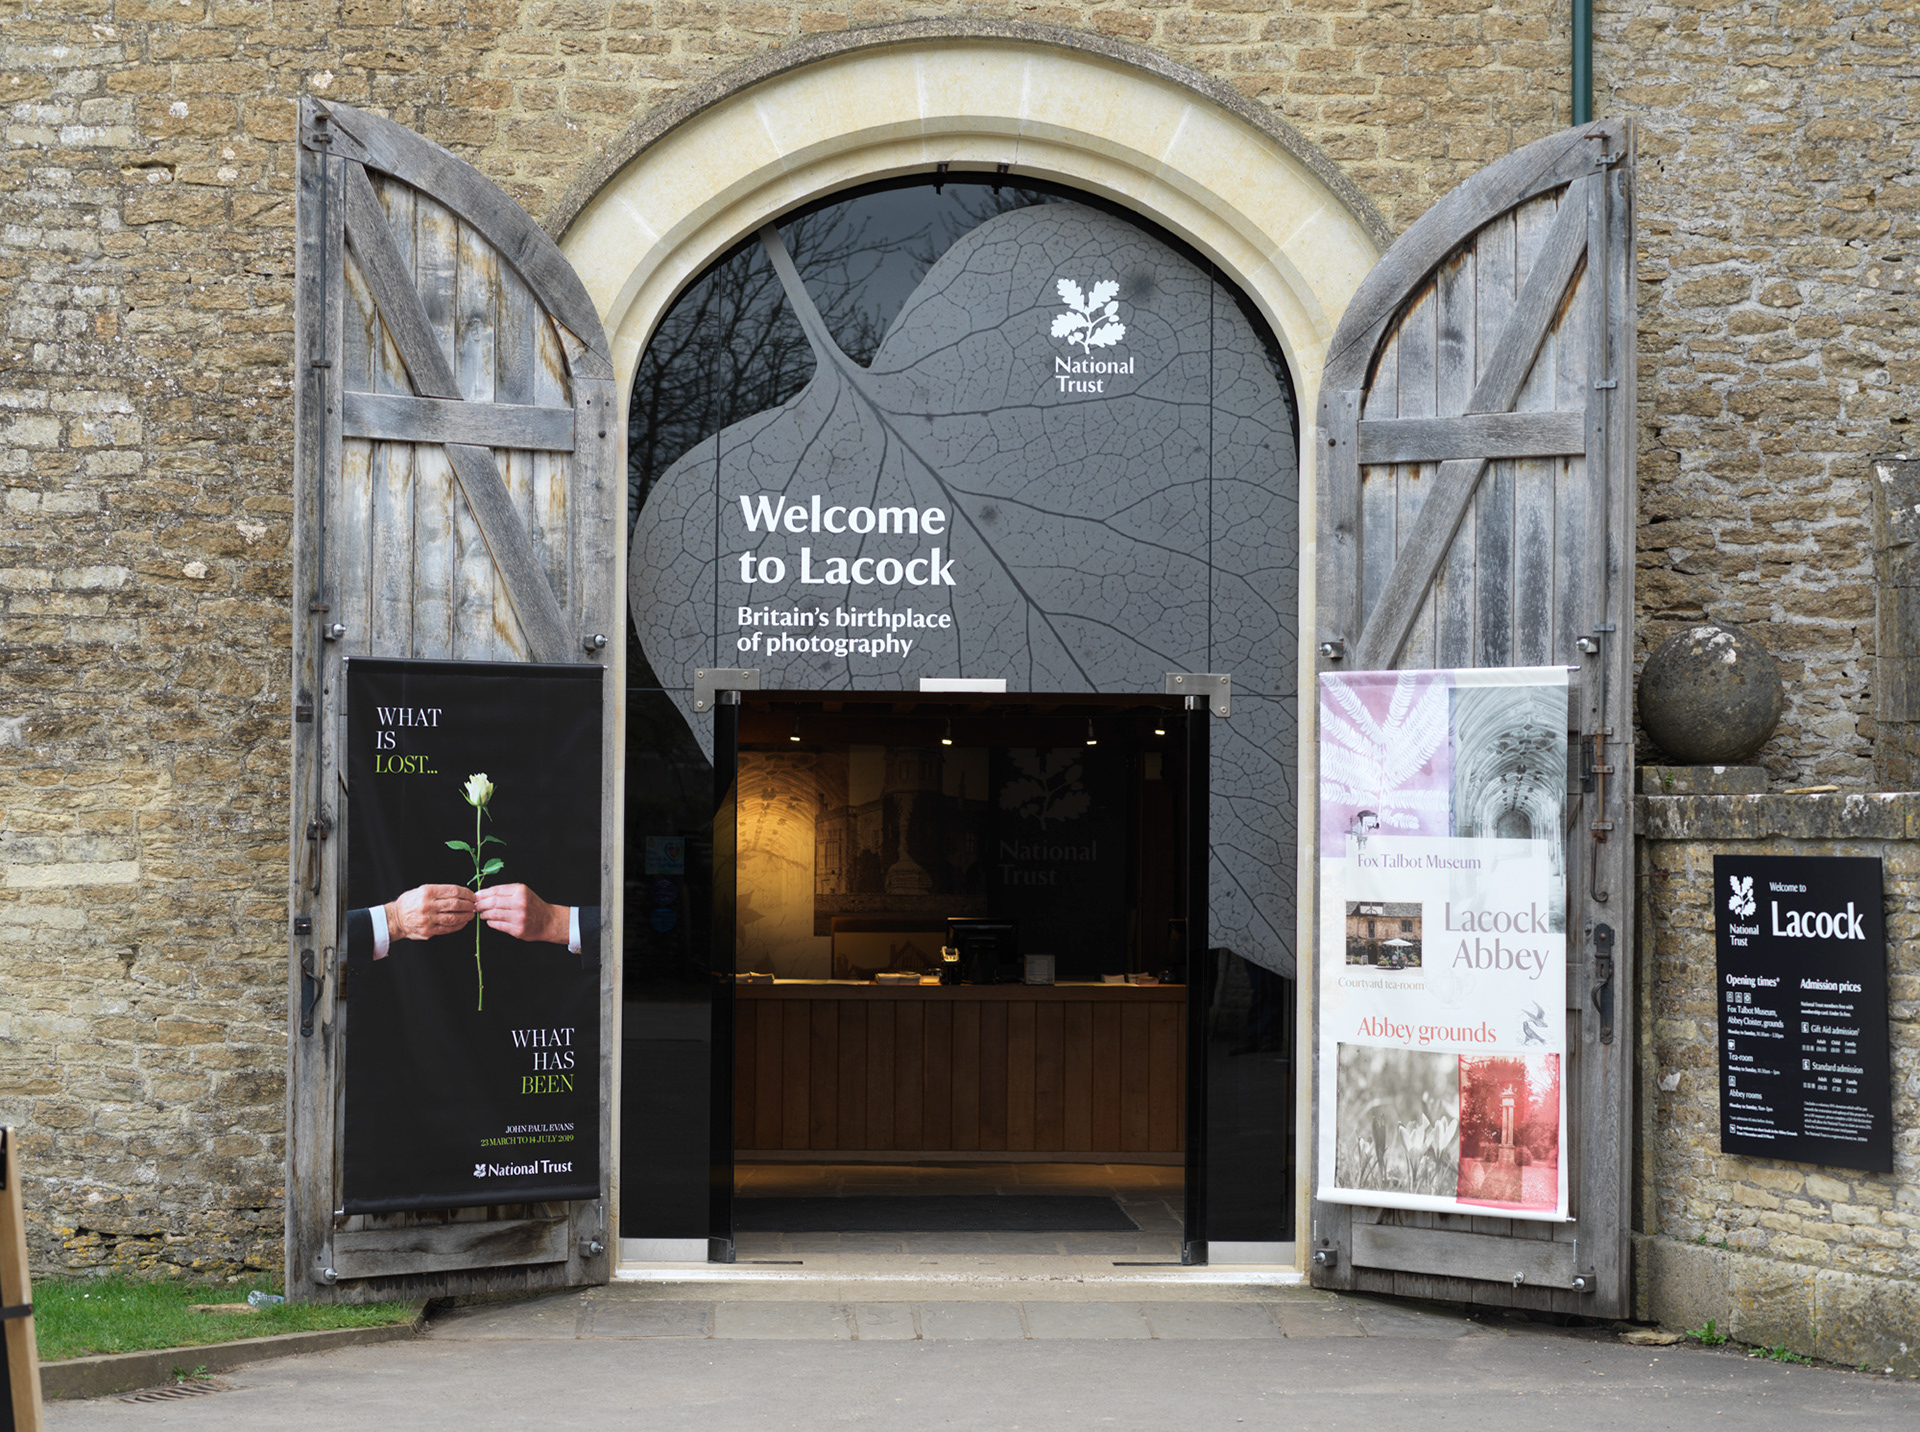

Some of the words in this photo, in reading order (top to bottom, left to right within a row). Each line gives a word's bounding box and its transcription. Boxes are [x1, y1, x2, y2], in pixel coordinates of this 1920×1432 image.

[1055, 356, 1134, 374] National
[1055, 375, 1104, 392] Trust
[739, 494, 946, 535] Welcome
[738, 550, 786, 584] to
[800, 547, 957, 586] Lacock
[737, 606, 830, 628] Britain’s
[836, 607, 951, 633] birthplace
[737, 632, 763, 652] of
[766, 632, 913, 658] photography
[376, 706, 442, 727] WHAT
[376, 730, 396, 750] IS
[375, 754, 438, 774] LOST...
[1000, 840, 1097, 861] National
[1357, 853, 1379, 868] Fox
[1380, 853, 1423, 869] Talbot
[1426, 854, 1482, 870] Museum
[998, 864, 1057, 886] Trust
[1769, 882, 1798, 893] Welcome
[1799, 883, 1807, 893] to
[1445, 901, 1549, 934] Lacock
[1771, 900, 1866, 940] Lacock
[1729, 924, 1760, 935] National
[1729, 935, 1748, 947] Trust
[1452, 937, 1550, 981] Abbey
[1338, 976, 1383, 991] Courtyard
[1385, 978, 1425, 991] tea-room
[1726, 974, 1756, 988] Opening
[1800, 978, 1838, 991] Admission
[1839, 981, 1862, 994] prices
[1727, 1005, 1737, 1013] Fox
[1737, 1005, 1754, 1014] Talbot
[1357, 1016, 1415, 1045] Abbey
[1418, 1021, 1497, 1046] grounds
[1727, 1016, 1743, 1026] Abbey
[1764, 1020, 1784, 1029] grounds
[1811, 1025, 1821, 1033] Gift
[1822, 1026, 1831, 1034] Aid
[511, 1028, 575, 1048] WHAT
[533, 1050, 575, 1071] HAS
[1728, 1052, 1754, 1062] Tea-room
[1812, 1061, 1836, 1072] Standard
[1837, 1064, 1864, 1074] admission
[521, 1074, 574, 1094] BEEN
[1729, 1089, 1745, 1099] Abbey
[1746, 1092, 1762, 1100] rooms
[506, 1124, 527, 1134] JOHN
[528, 1124, 548, 1133] PAUL
[549, 1122, 574, 1132] EVANS
[480, 1139, 489, 1147] 23
[489, 1137, 516, 1146] MARCH
[517, 1136, 528, 1144] TO
[536, 1135, 557, 1143] JULY
[558, 1134, 574, 1143] 2019
[488, 1160, 538, 1177] National
[540, 1159, 573, 1174] Trust
